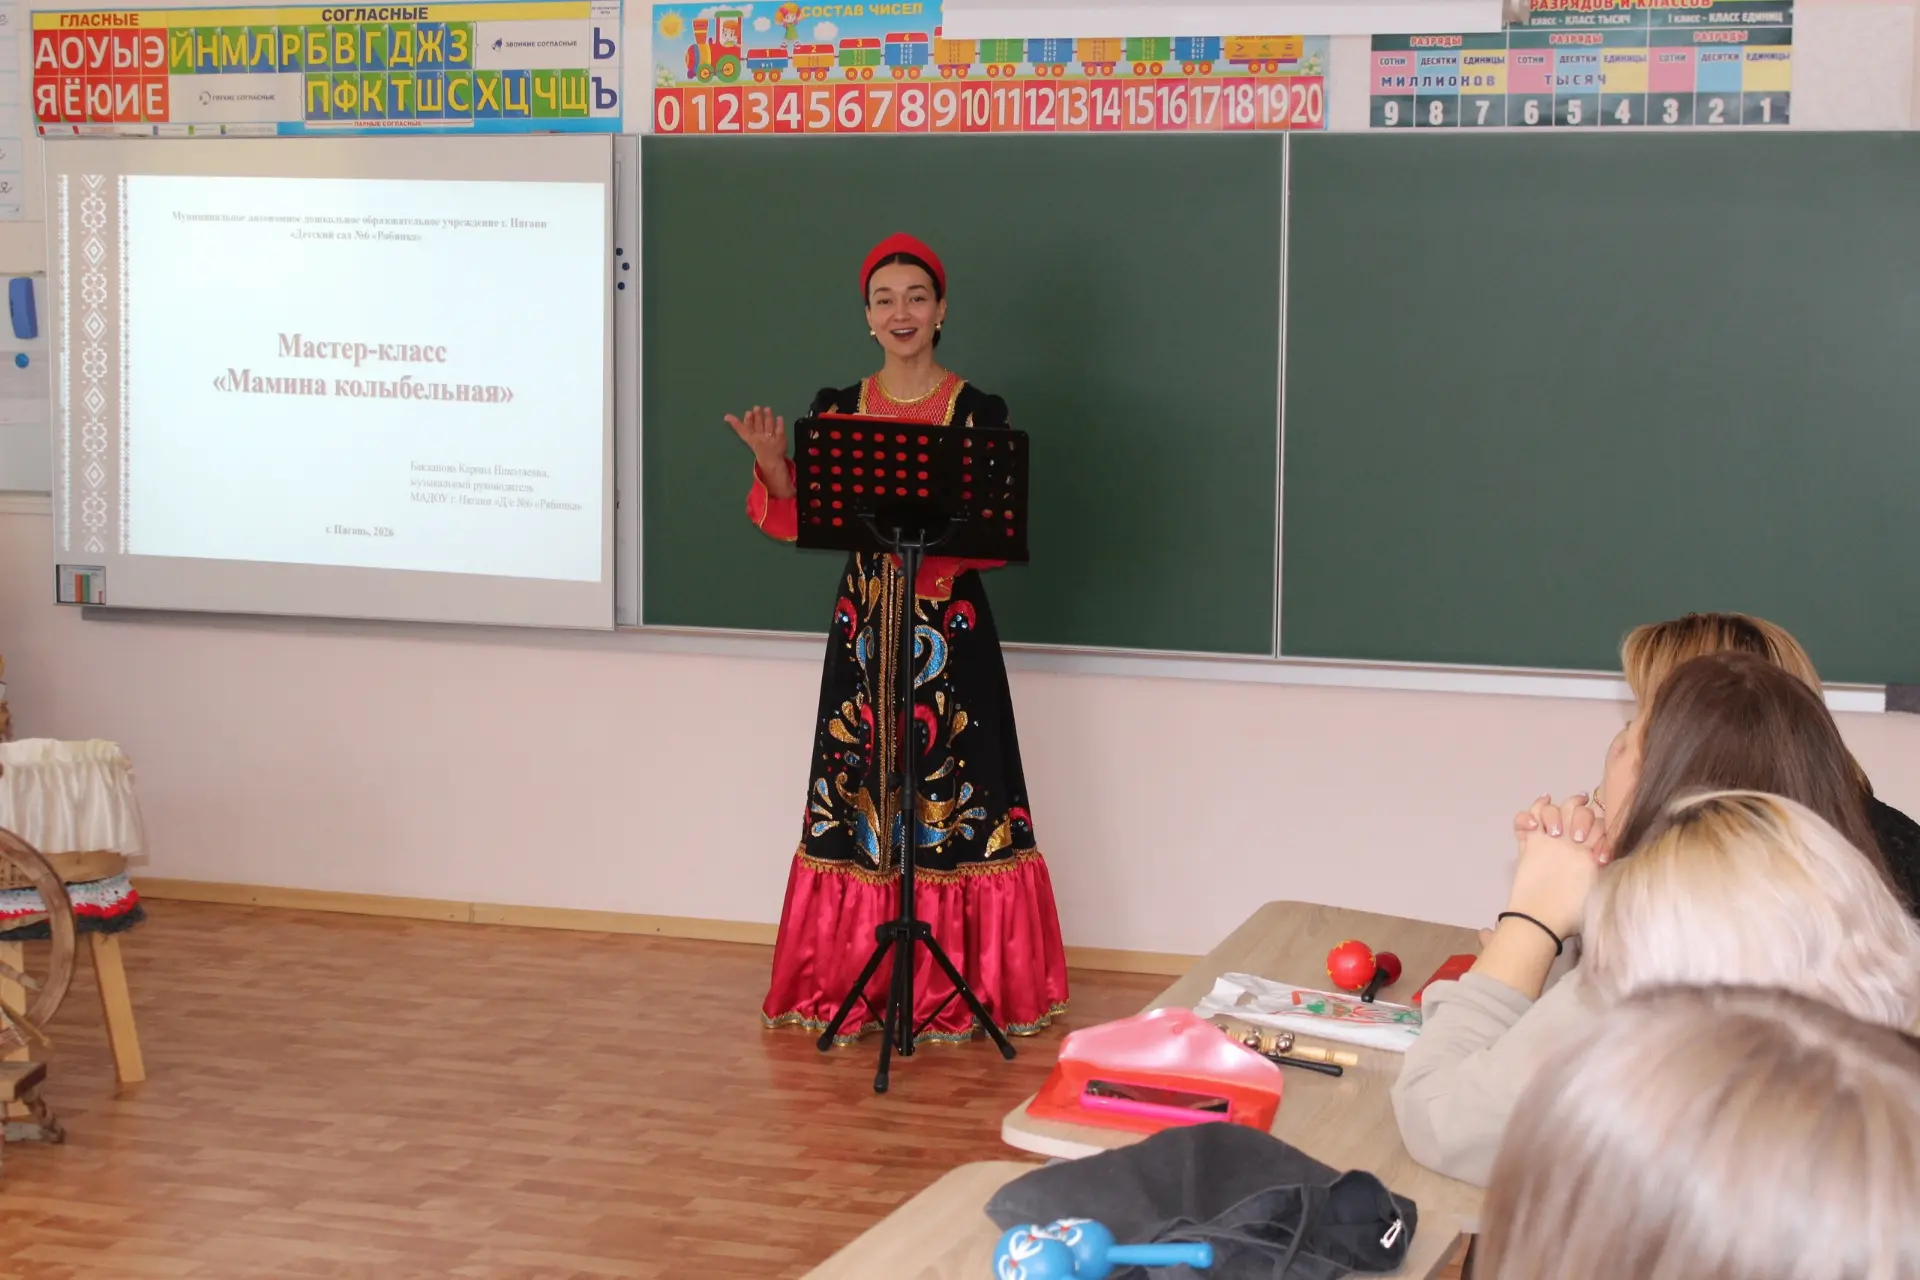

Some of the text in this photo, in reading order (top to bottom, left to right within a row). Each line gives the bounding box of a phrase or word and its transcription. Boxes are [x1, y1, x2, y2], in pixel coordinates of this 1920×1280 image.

[800, 3, 923, 17] СОСТАВ ЧИСЕЛ
[1530, 0, 1711, 10] РАЗРЯДОВ И КЛАССОВ
[60, 13, 139, 27] ГЛАСНЫЕ
[322, 7, 429, 22] СОГЛАСНЫЕ
[1709, 12, 1741, 22] КЛАСС
[1410, 36, 1462, 47] РАЗРЯДЫ
[1549, 33, 1603, 44] РАЗРЯДЫ
[1693, 31, 1748, 42] РАЗРЯДЫ
[593, 27, 616, 59] Ь
[1380, 56, 1505, 66] СОТНИ ДЕСЯТКИ ЕДИНИЦЫ
[1517, 55, 1646, 64] СОТНИ ДЕСЯТКИ ЕДИНИЦЫ
[1659, 52, 1790, 63] СОТНИ ДЕСЯТКИ ЕДИНИЦЫ
[591, 76, 617, 109] Ъ
[657, 84, 1323, 131] 0 1 2 3 4 5 6 7 8 9 10 11 12 13 14 15 16 17 18 19 20
[1384, 97, 1771, 125] 9 8 7 6 5 4 3 2 1
[248, 214, 300, 223] автономное
[303, 216, 360, 224] дошкольное
[362, 216, 439, 228] образовательное
[443, 219, 498, 229] учреждение
[336, 231, 352, 240] сад
[355, 230, 369, 240] №6
[277, 332, 447, 367] Мастер-класс
[212, 368, 514, 403] «Мамина колыбельная»
[473, 482, 534, 493] руководитель
[410, 492, 448, 504] МАДОУ
[373, 526, 394, 537] 2026
